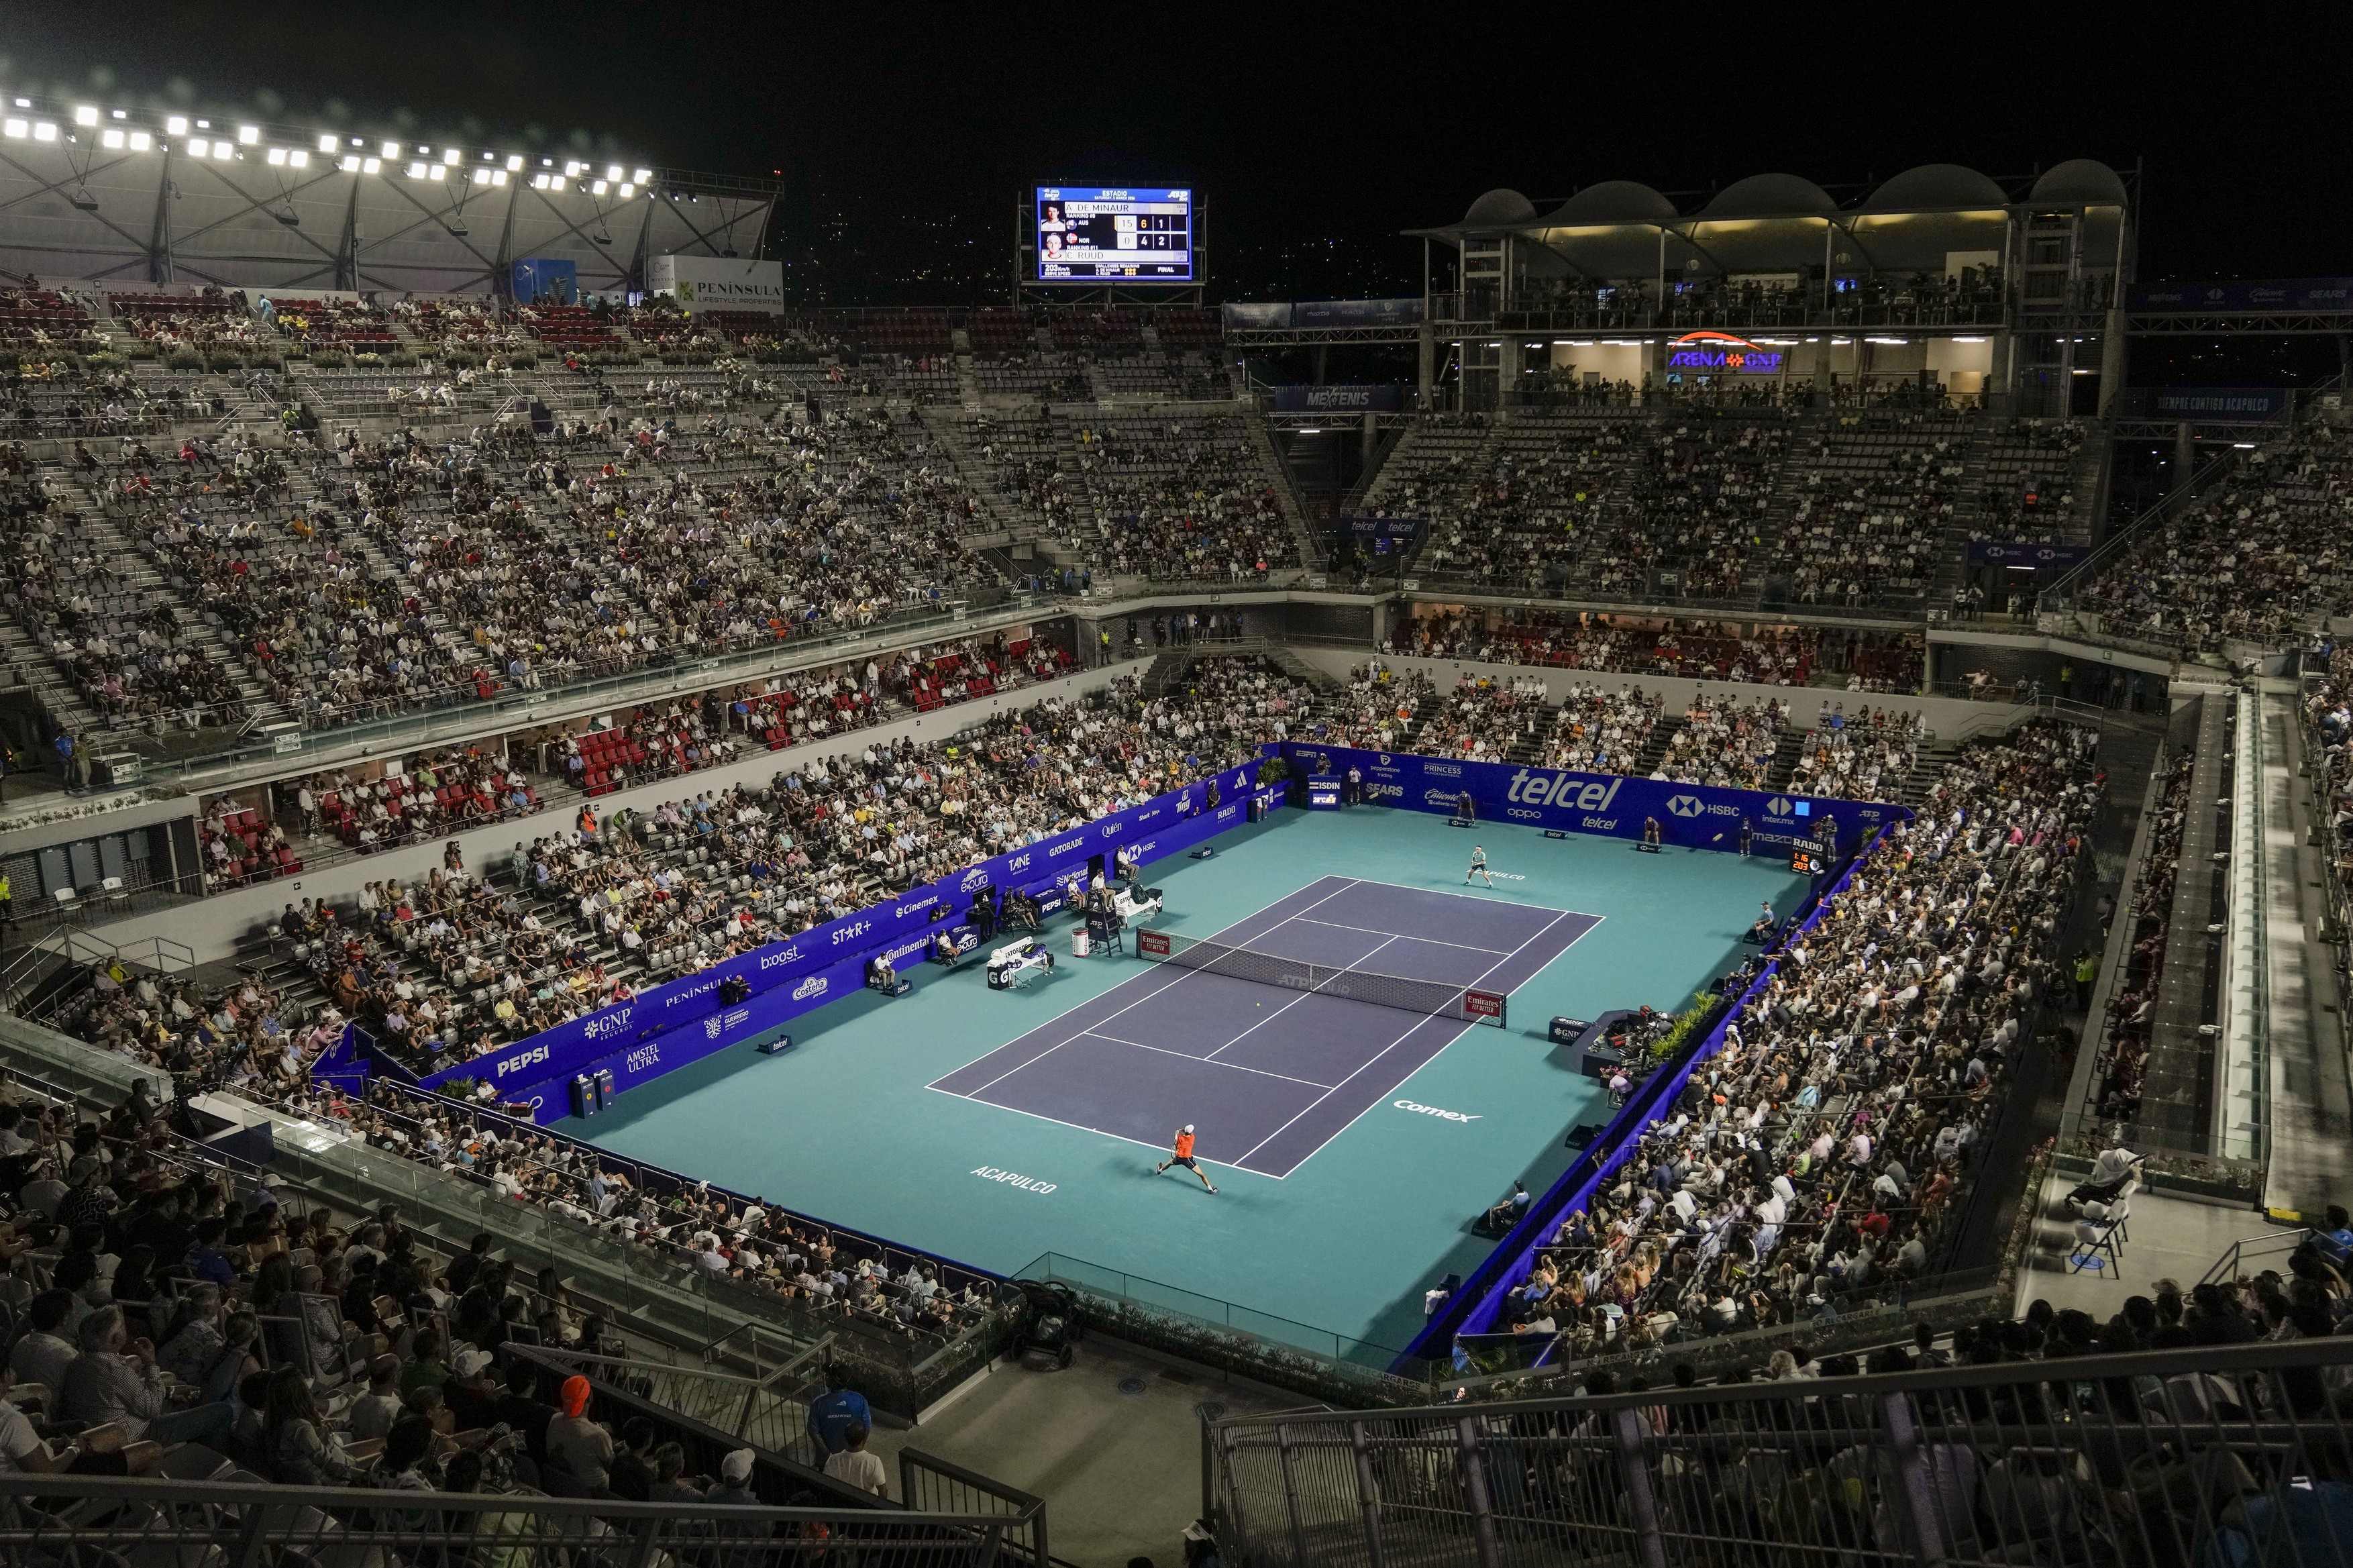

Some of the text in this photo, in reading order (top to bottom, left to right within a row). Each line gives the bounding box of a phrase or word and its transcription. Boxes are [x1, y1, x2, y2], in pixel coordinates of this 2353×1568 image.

[1122, 219, 1163, 228] 15 6 1
[1141, 237, 1147, 246] 4
[1159, 237, 1165, 246] 2
[698, 282, 781, 295] PENÍNSULA
[1669, 352, 1781, 366] ARENA GNP
[1307, 388, 1369, 409] MEXTENIS
[2158, 397, 2268, 411] SIEMPRE CONTIGO ACAPULCO
[1351, 521, 1377, 531] telcel
[1388, 523, 1415, 532] telcel
[1424, 764, 1461, 774] PRINCESS
[1365, 783, 1403, 796] SEARS
[1424, 788, 1459, 801] Caliente
[1508, 769, 1623, 811] telcel
[1176, 798, 1192, 814] Ting
[1217, 805, 1236, 819] RADO
[1708, 804, 1740, 817] HSBC
[1139, 813, 1151, 821] Shark
[1507, 808, 1541, 819] oppo
[1762, 815, 1795, 825] inter.mx
[1859, 810, 1880, 818] ATP
[1582, 816, 1618, 830] telcel
[1102, 823, 1122, 838] Quién
[1049, 837, 1084, 857] GATORADE
[1143, 841, 1156, 853] HSBC
[1792, 847, 1823, 856] SWITZERLAND
[1793, 838, 1823, 852] RADO
[1008, 853, 1030, 871] TANE
[1793, 861, 1808, 870] 203
[904, 895, 939, 914] Cinemex
[1042, 898, 1061, 912] PEPSI
[1143, 935, 1168, 946] Emirates
[886, 935, 929, 963] Continental
[989, 972, 998, 984] G
[796, 980, 824, 997] Costeña
[898, 982, 910, 994] telcel
[1467, 996, 1498, 1008] Emirates
[1479, 1004, 1494, 1013] BETTER
[600, 1008, 631, 1033] GNP
[725, 1010, 749, 1024] GUERRERO
[600, 1024, 633, 1041] SEGUROS
[1562, 1029, 1580, 1038] GNP
[773, 1038, 788, 1050] telcel
[627, 1043, 660, 1065] AMSTEL
[498, 1045, 550, 1078] PEPSI
[629, 1055, 660, 1073] ULTRA
[1394, 1100, 1483, 1122] Comex
[970, 1165, 1057, 1194] ACAPULCO
[1139, 1302, 1208, 1327] NO RECARGARSE
